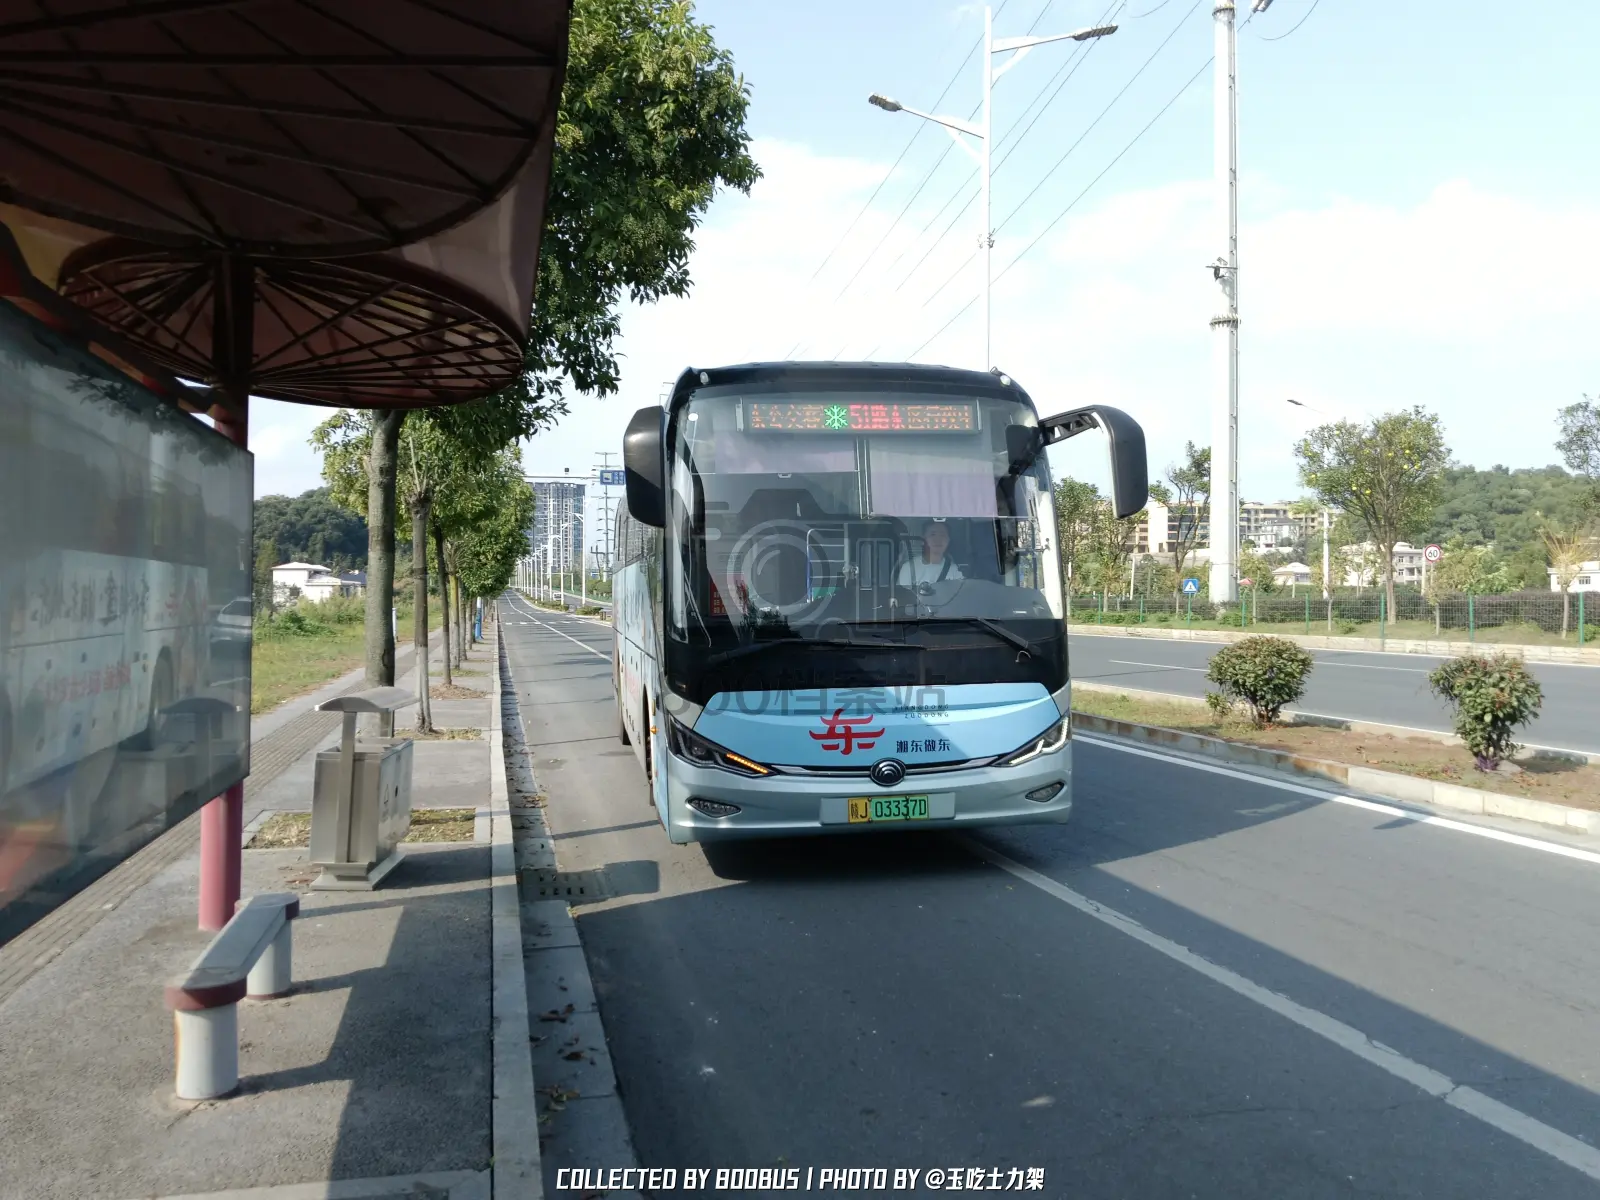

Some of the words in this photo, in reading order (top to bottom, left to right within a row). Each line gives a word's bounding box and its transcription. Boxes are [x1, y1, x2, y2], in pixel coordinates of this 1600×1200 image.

[809, 708, 885, 755] 东
[896, 738, 950, 753] 湘东做东
[874, 798, 927, 818] 03337D
